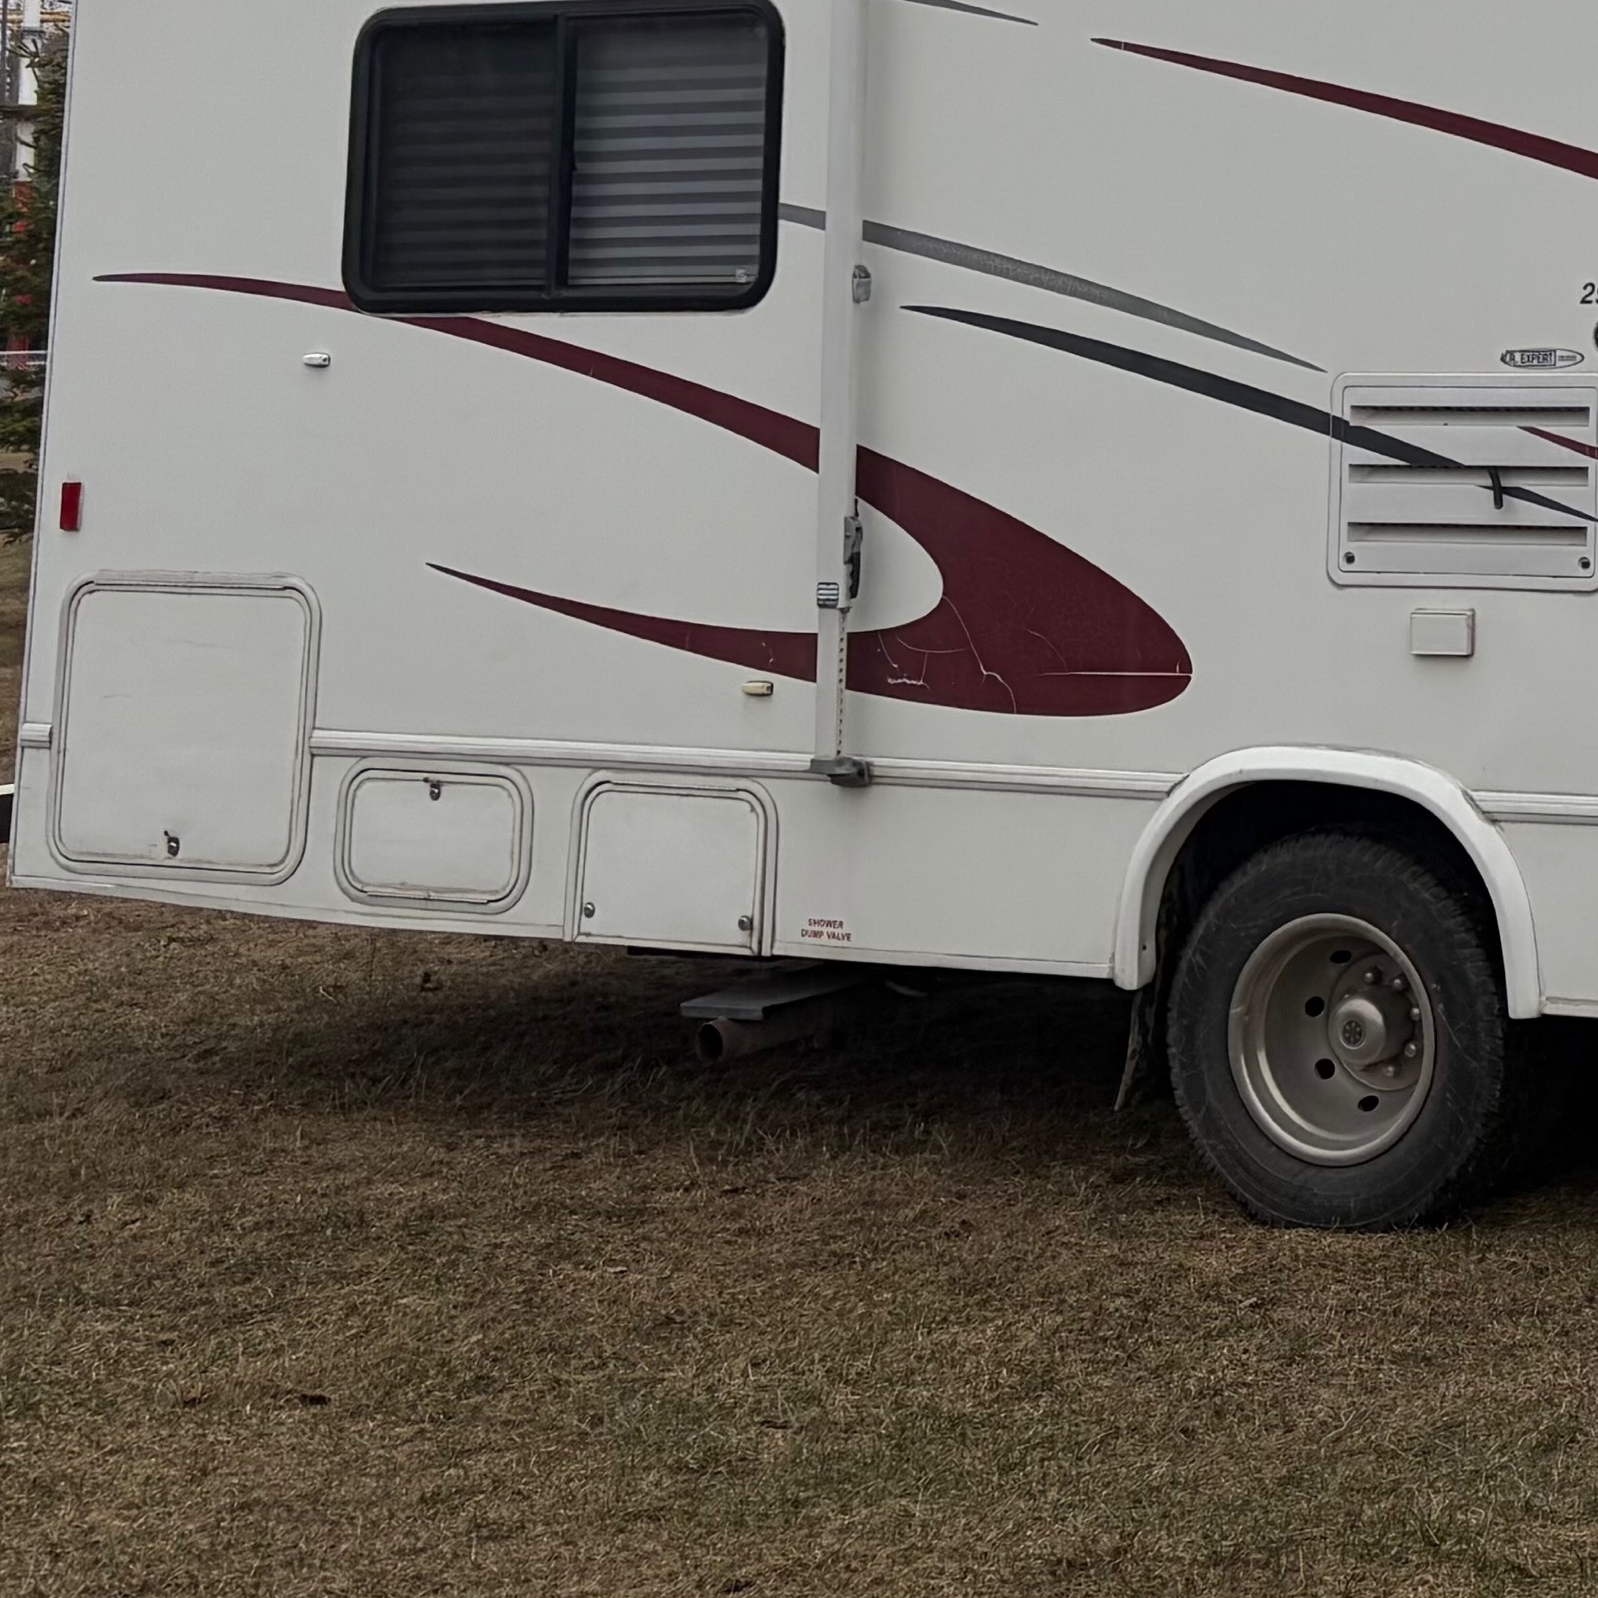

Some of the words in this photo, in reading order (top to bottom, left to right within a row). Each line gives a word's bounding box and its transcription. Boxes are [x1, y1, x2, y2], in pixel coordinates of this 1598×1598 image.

[807, 918, 844, 929] SHOWER
[800, 928, 824, 939] DUMP
[826, 931, 852, 942] VALVE
